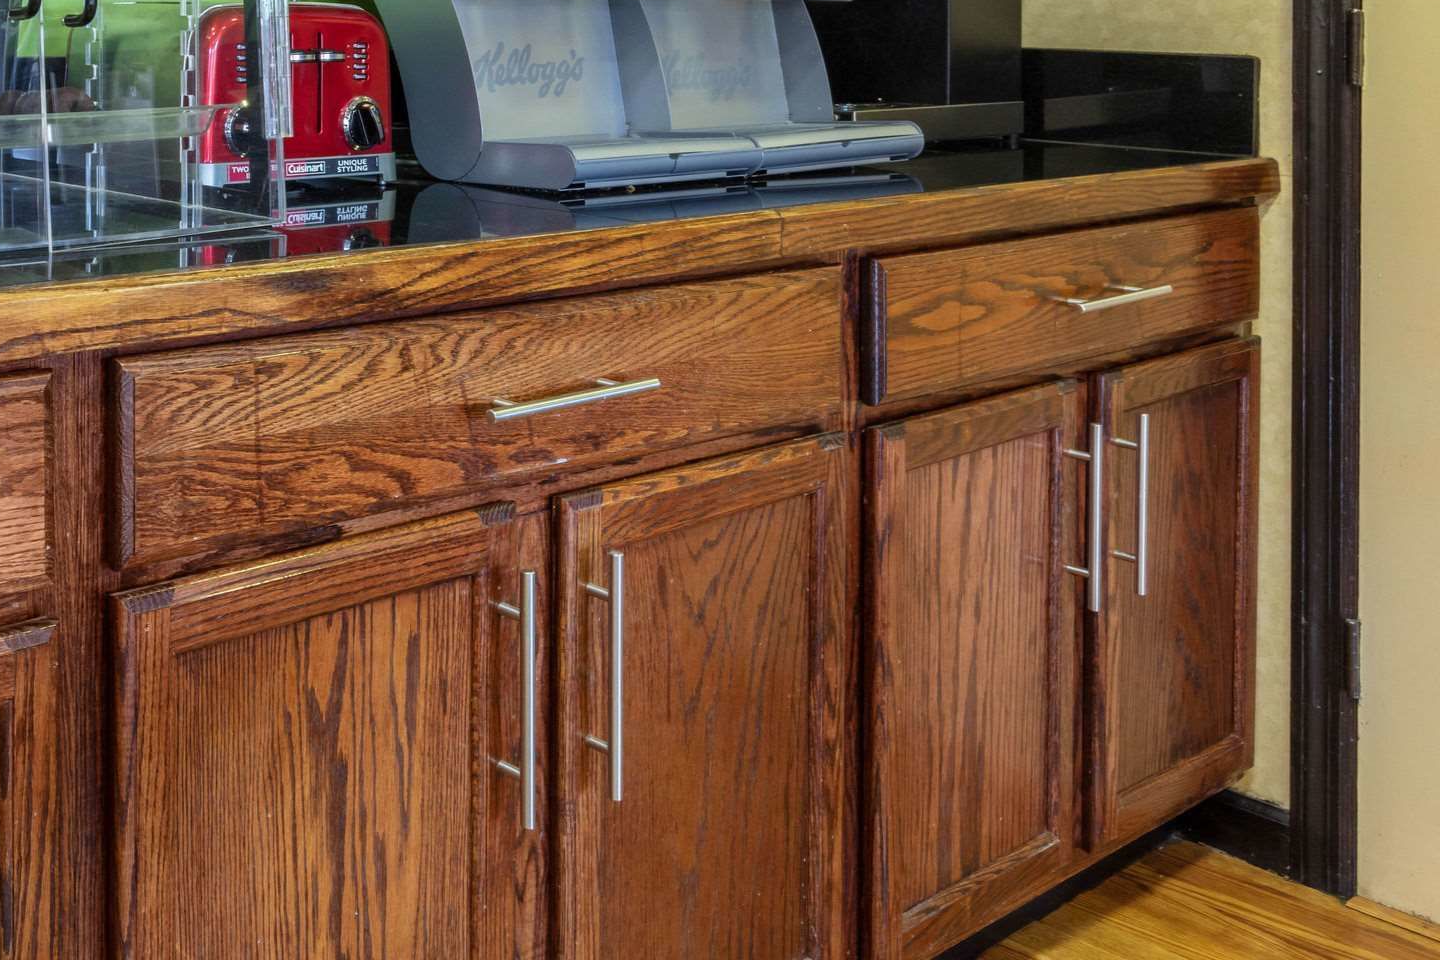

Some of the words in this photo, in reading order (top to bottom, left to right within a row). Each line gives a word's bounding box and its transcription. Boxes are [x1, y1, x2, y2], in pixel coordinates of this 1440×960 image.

[474, 41, 584, 98] Kellogg's
[338, 158, 368, 167] UNIQUE
[232, 166, 249, 174] TWO
[288, 162, 323, 174] Cuisinart
[337, 165, 368, 173] STYLING
